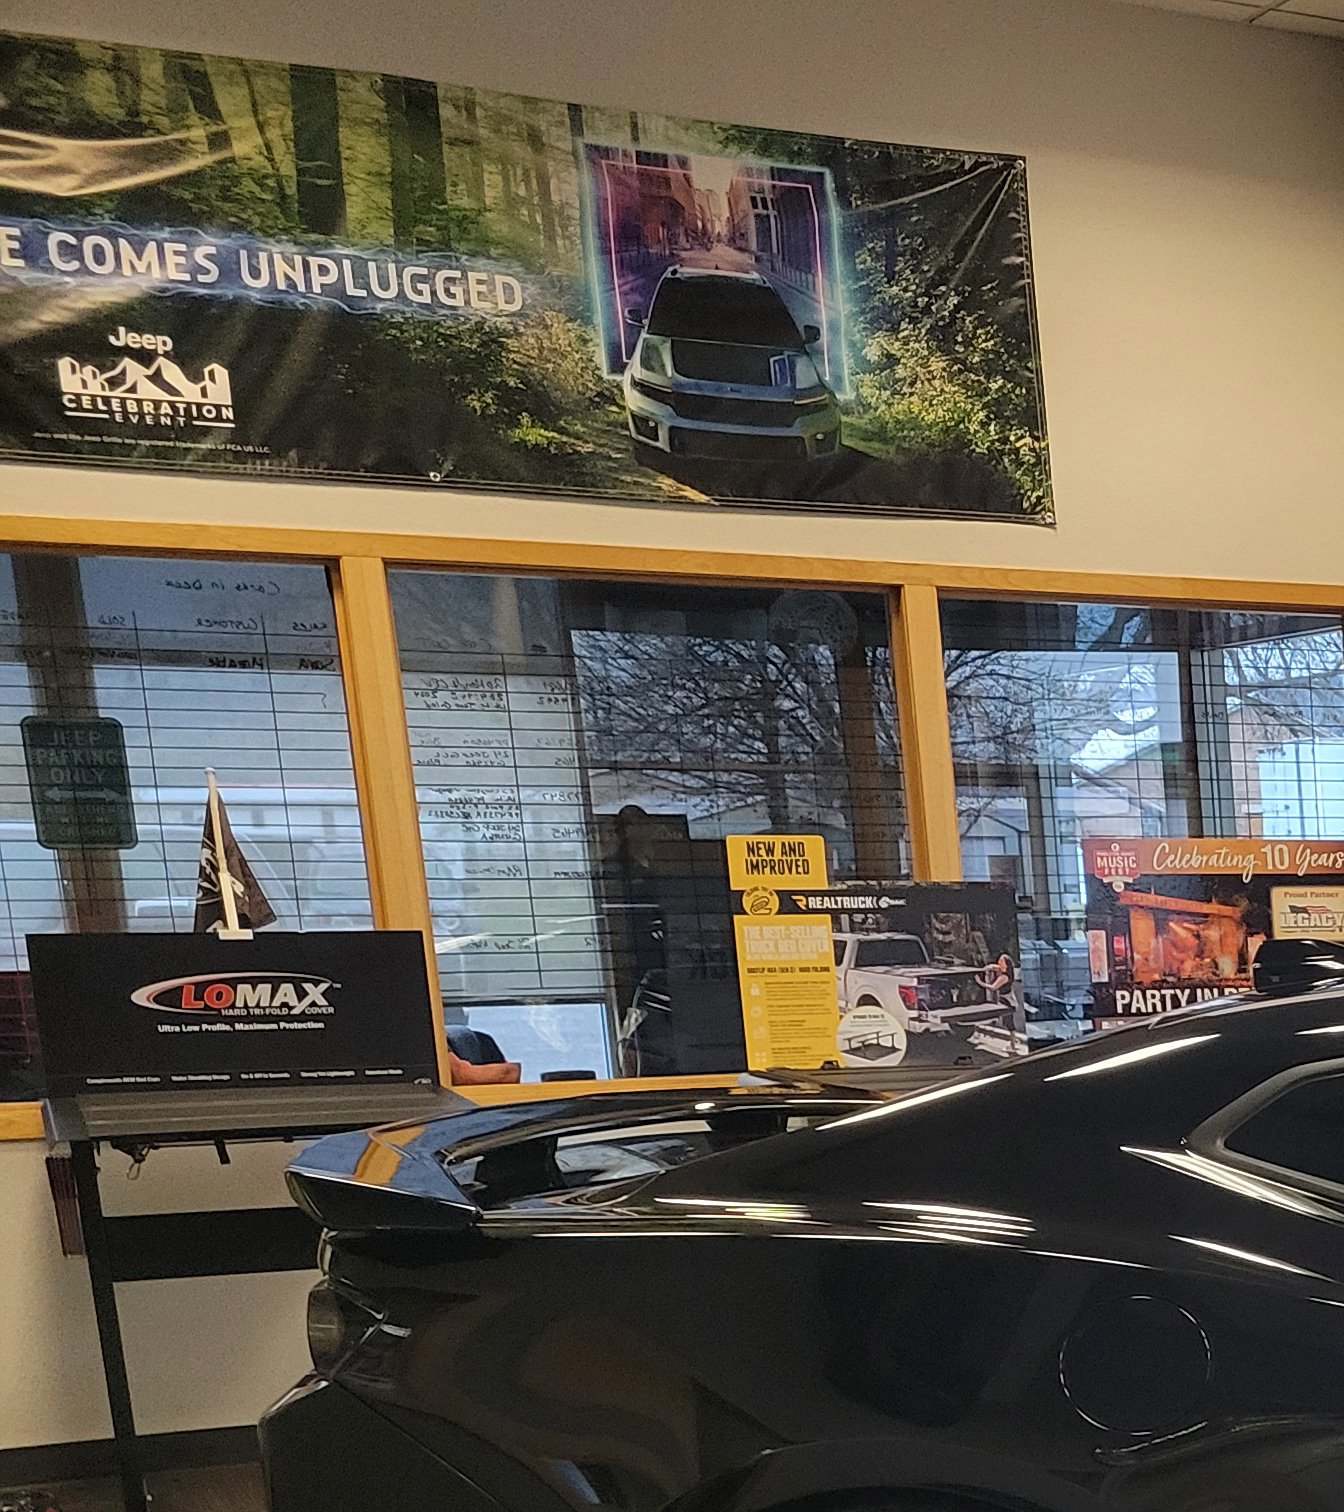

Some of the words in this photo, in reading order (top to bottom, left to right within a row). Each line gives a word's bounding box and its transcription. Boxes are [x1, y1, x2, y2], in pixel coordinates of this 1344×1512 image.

[47, 231, 220, 283] COMES
[239, 249, 523, 312] UNPLUGGED
[108, 326, 174, 354] Jeep
[62, 394, 235, 420] CELEBRATION
[115, 413, 188, 427] EVENT
[746, 841, 776, 858] NEW
[780, 841, 806, 857] AND
[745, 859, 810, 876] IMPROVED
[1096, 856, 1137, 868] MUSIC
[1153, 842, 1261, 883] Celebrating
[1261, 843, 1290, 870] 10
[1279, 911, 1344, 927] LEGACY
[181, 982, 333, 1014] LOMAX
[1115, 988, 1191, 1014] PARTY
[1196, 987, 1220, 1001] IN
[221, 1008, 248, 1016] HARD
[250, 1007, 289, 1016] TRI-FOLD
[305, 1006, 334, 1015] COVER
[158, 1024, 180, 1033] Ultra
[182, 1024, 200, 1032] Low
[235, 1022, 278, 1031] Maximum
[280, 1021, 325, 1030] Protection
